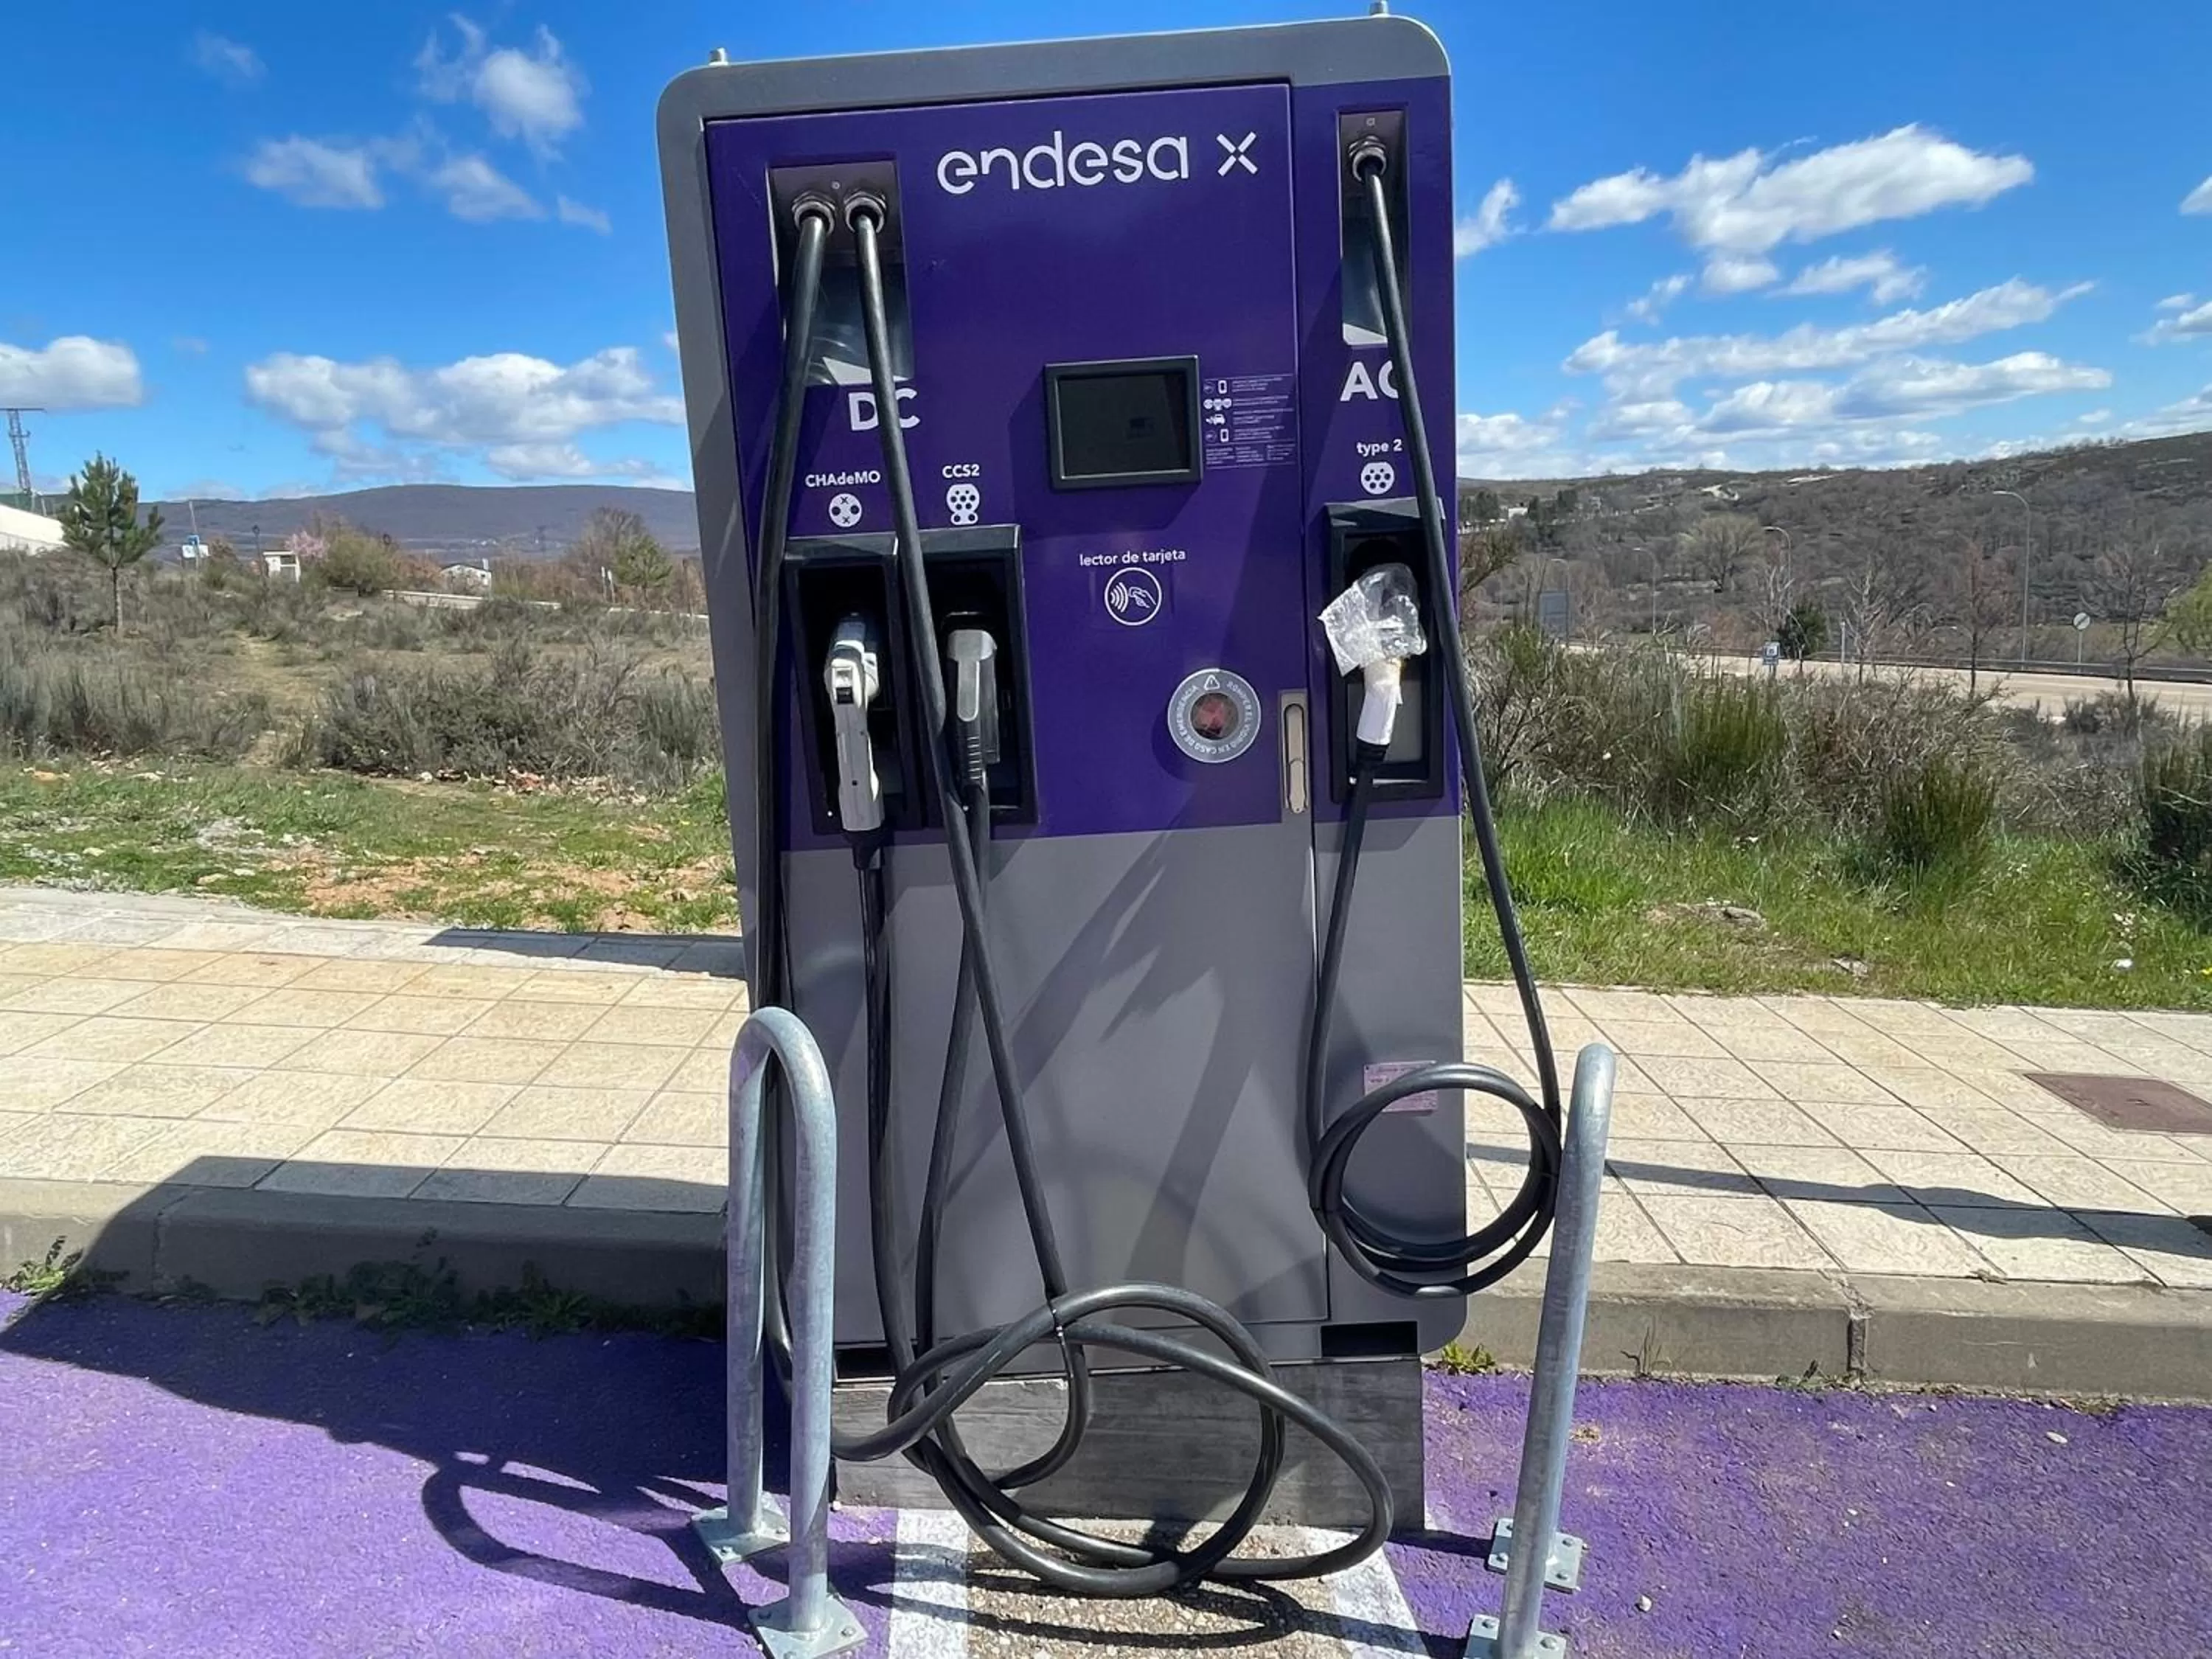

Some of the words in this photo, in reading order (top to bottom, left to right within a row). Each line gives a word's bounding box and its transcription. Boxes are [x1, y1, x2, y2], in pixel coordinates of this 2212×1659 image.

[937, 130, 1189, 195] endesa
[1340, 360, 1399, 402] AC
[848, 387, 921, 431] DC
[1356, 441, 1389, 457] type
[1392, 439, 1403, 452] 2
[804, 470, 881, 488] CHAdeMO
[942, 464, 981, 479] CCS2
[1079, 553, 1119, 567] lector
[1121, 550, 1140, 564] de
[1142, 548, 1186, 565] tarjeta
